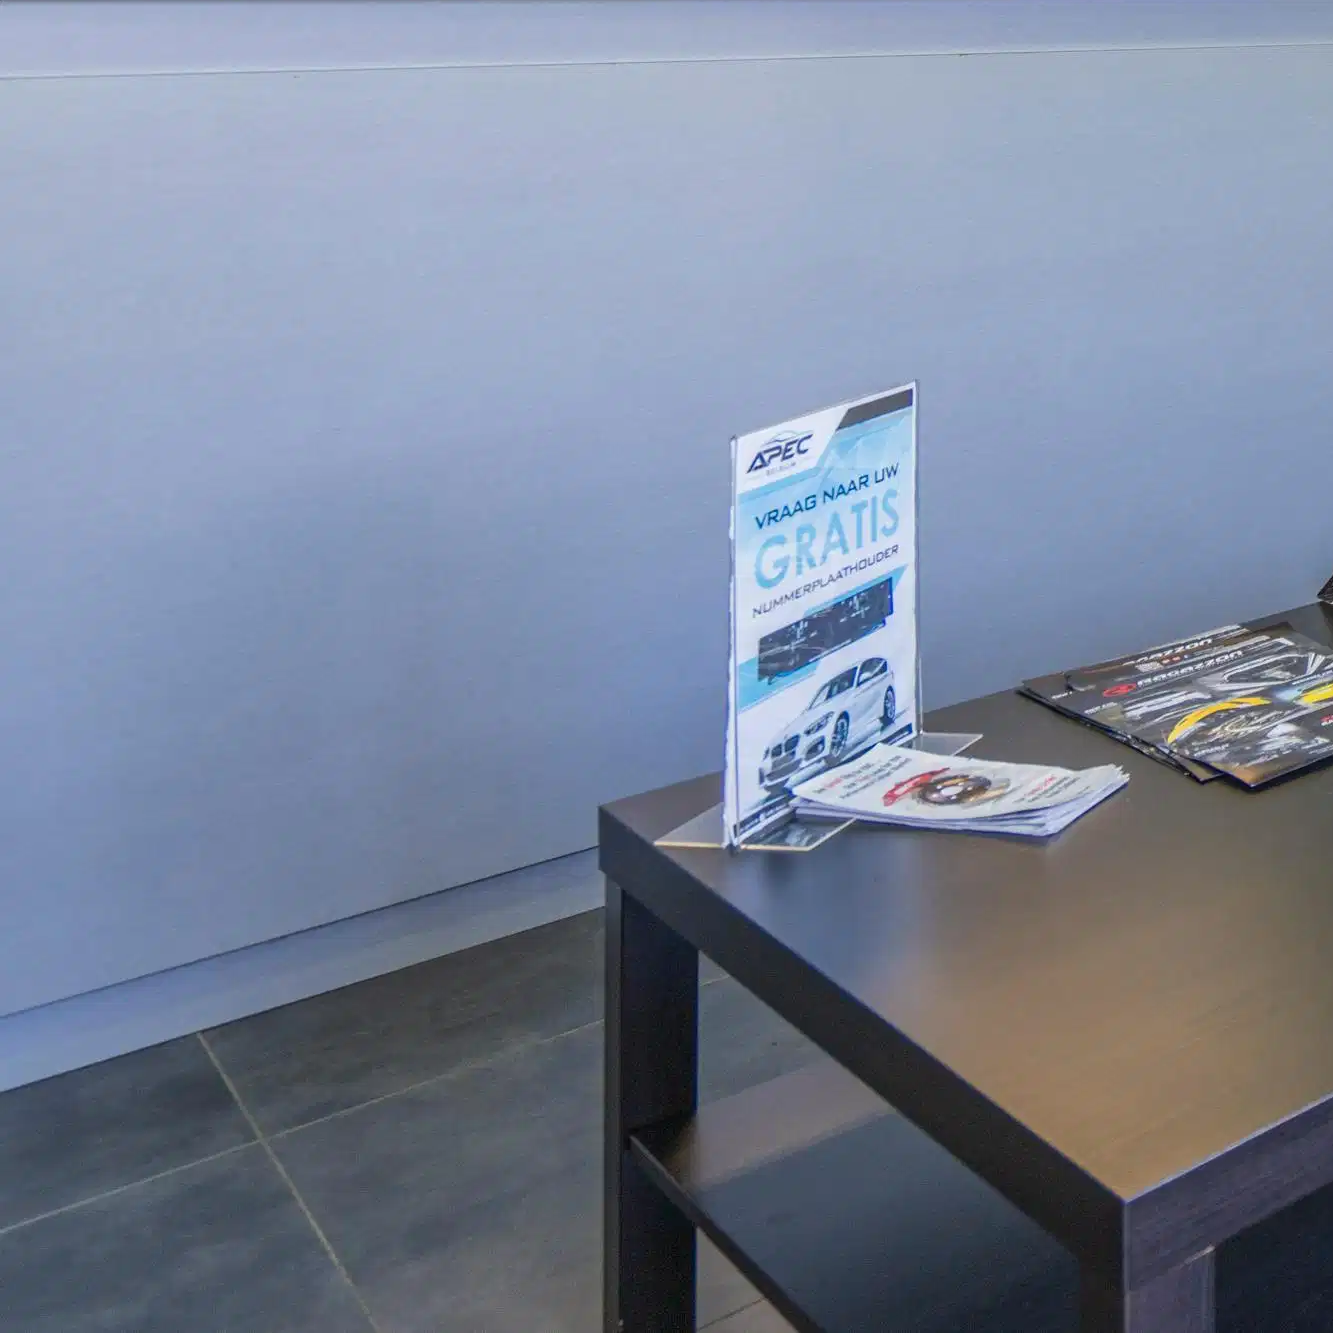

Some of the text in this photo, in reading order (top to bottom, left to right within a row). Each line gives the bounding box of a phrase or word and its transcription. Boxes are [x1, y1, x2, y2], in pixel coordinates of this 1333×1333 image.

[746, 433, 814, 475] APEC
[755, 462, 900, 531] VRAAG NAAR UW
[754, 487, 900, 591] GRATIS
[752, 544, 899, 618] NUMMERPLAATHOUDER
